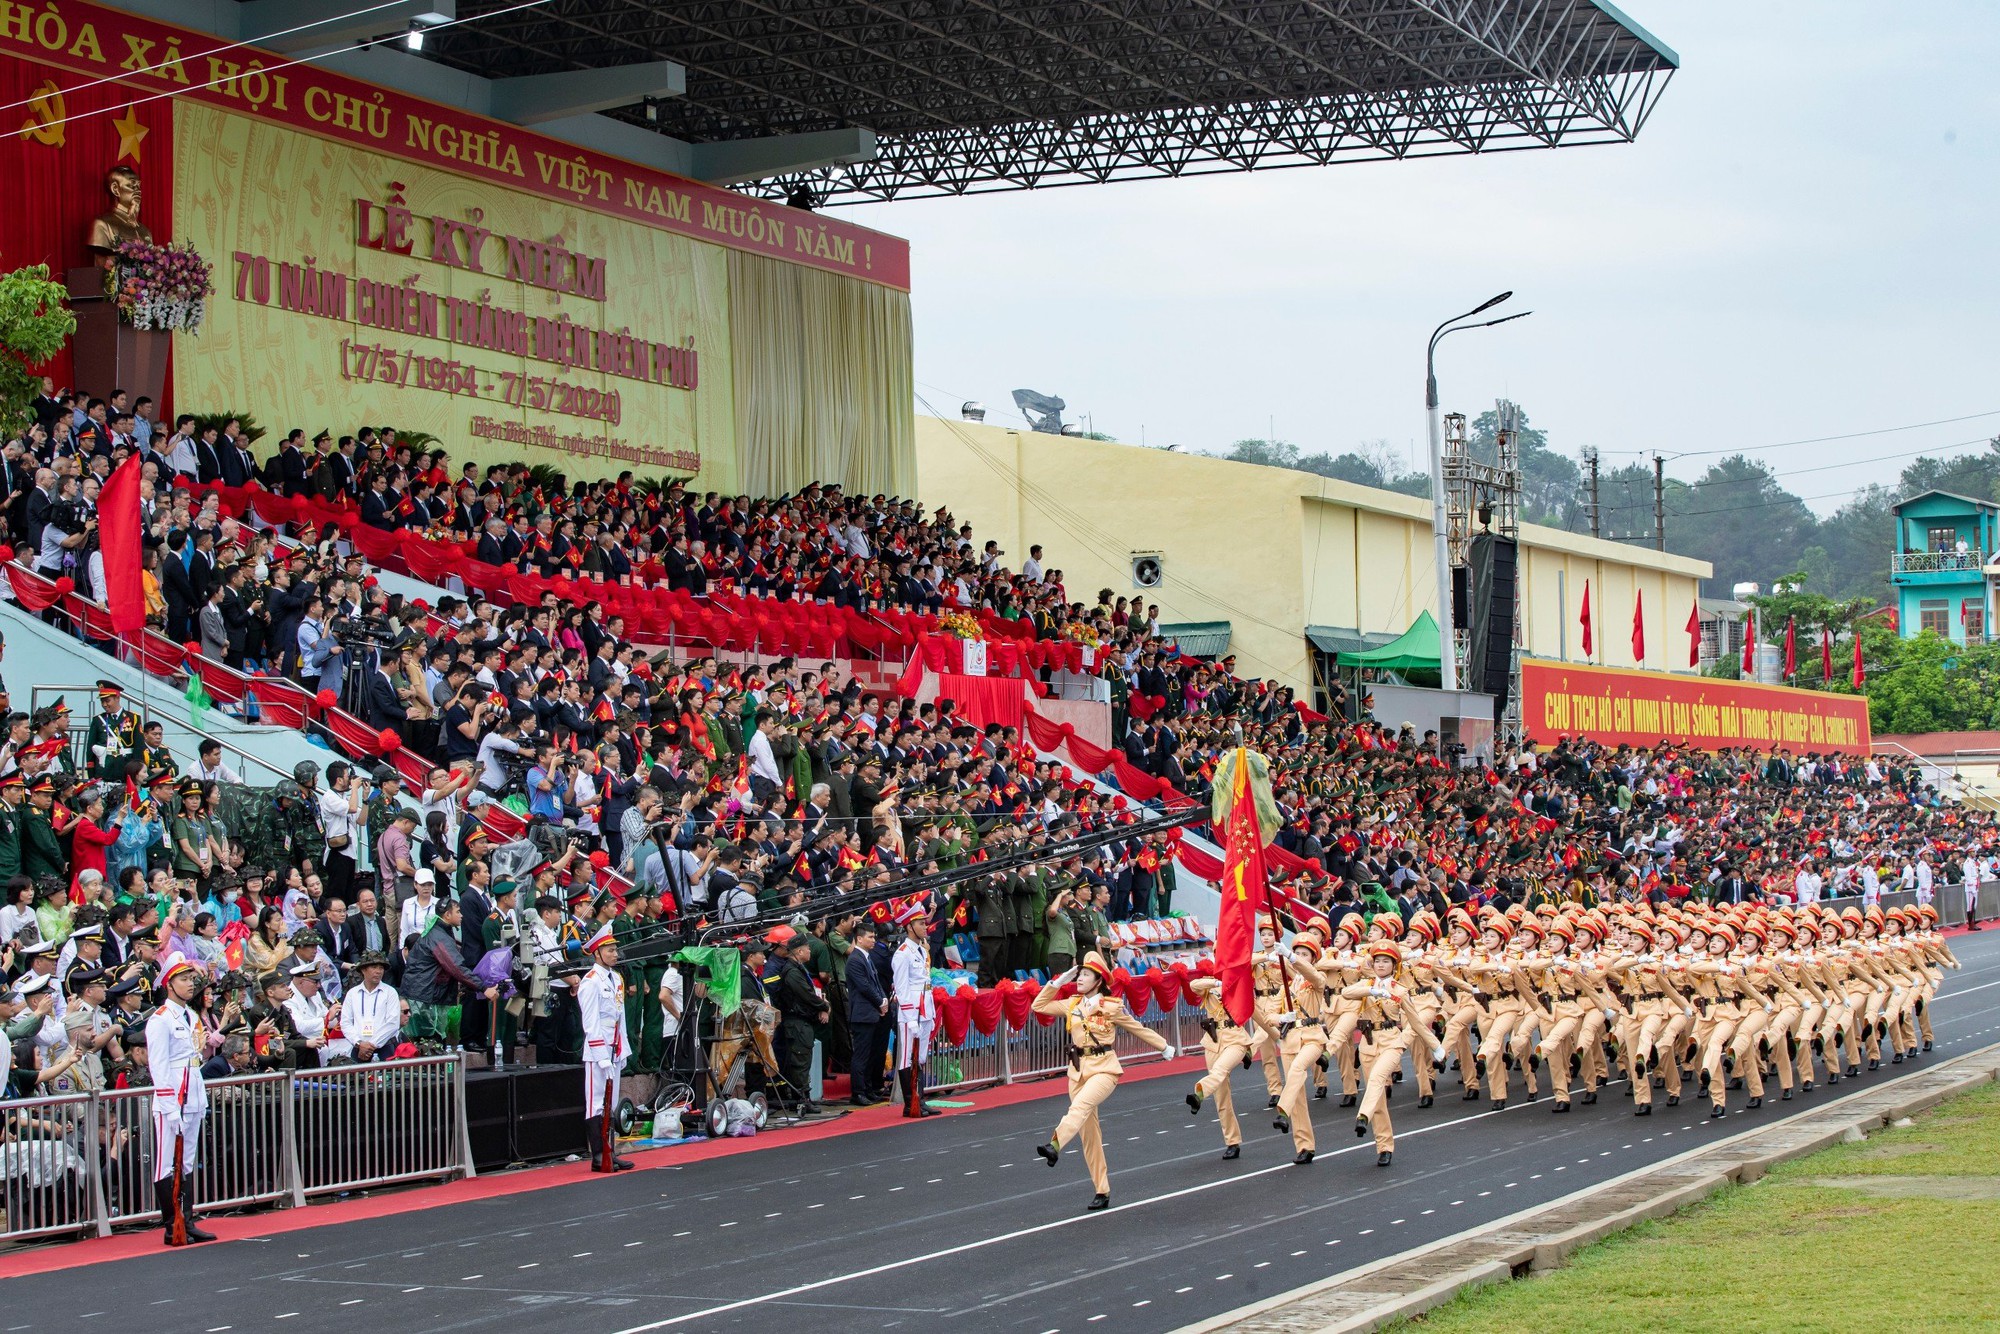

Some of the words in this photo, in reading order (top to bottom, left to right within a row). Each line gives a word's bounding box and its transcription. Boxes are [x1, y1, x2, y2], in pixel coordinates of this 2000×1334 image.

[0, 2, 106, 63] HÒA
[120, 36, 190, 85] XÃ
[205, 56, 289, 112] HỘI
[304, 92, 391, 139] CHỦ
[405, 114, 525, 178] NGHĨA
[534, 151, 614, 201] VIỆT
[623, 177, 692, 224] NAM
[702, 201, 786, 249] MUÔN
[795, 223, 856, 266] NĂM
[864, 243, 872, 271] !
[357, 181, 415, 256] LỄ
[431, 207, 491, 273] KỶ
[505, 233, 607, 305] NIỆM
[234, 251, 270, 305] 70
[281, 255, 346, 321] NĂM
[357, 274, 438, 338] CHIẾN
[446, 288, 529, 357] THẮNG
[597, 326, 649, 381] BIÊN
[656, 335, 699, 391] PHỦ
[501, 371, 621, 427] 7/5/2024)
[1544, 677, 1570, 731] CHỦ
[1572, 694, 1597, 737] TỊCH
[1598, 684, 1613, 733] HỒ
[1614, 690, 1632, 733] CHÍ
[1633, 698, 1661, 734] MINH
[1661, 694, 1672, 735] VĨ
[1673, 702, 1691, 743] ĐẠI
[1692, 692, 1720, 737] SỐNG
[1721, 700, 1740, 739] MÃI
[1741, 707, 1770, 740] TRONG
[1771, 708, 1783, 747] SỰ
[1783, 707, 1808, 750] NGHIỆP
[1809, 702, 1825, 744] CỦA
[1825, 710, 1847, 746] CHÚNG
